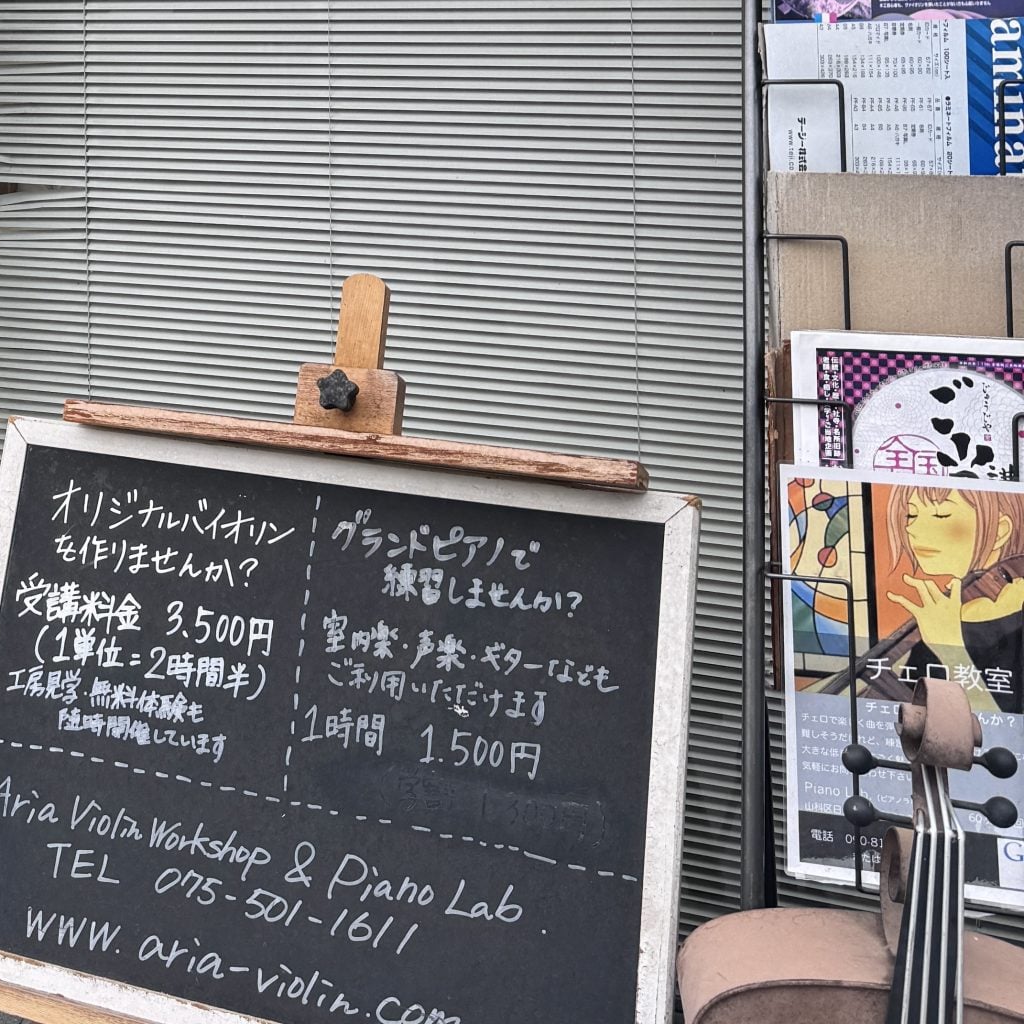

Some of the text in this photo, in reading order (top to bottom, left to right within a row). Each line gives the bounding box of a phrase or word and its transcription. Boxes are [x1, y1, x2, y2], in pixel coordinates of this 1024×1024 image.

[51, 479, 295, 545] オリジナルバイオリン
[331, 508, 541, 570] グランドピアノで
[54, 534, 259, 587] を作りませんか?
[15, 572, 142, 634] 受講料金
[381, 562, 583, 619] 練習しませんか?
[322, 608, 620, 693] 室内楽・声楽・ギターなども
[866, 656, 1015, 695] チェロ教室
[6, 667, 205, 724] 工房見学・無料体験も
[327, 657, 548, 726] ご利用いただけます
[58, 708, 227, 763] 随時開催しています
[300, 704, 386, 757] 1時間
[804, 782, 840, 796] Piano
[845, 785, 872, 801] Lb.
[69, 794, 144, 843] Violin
[148, 819, 273, 881] Workshop
[275, 841, 314, 884] &
[328, 848, 436, 908] Piano
[810, 827, 834, 842] 電話
[46, 843, 420, 956] TEL 075-501-1611
